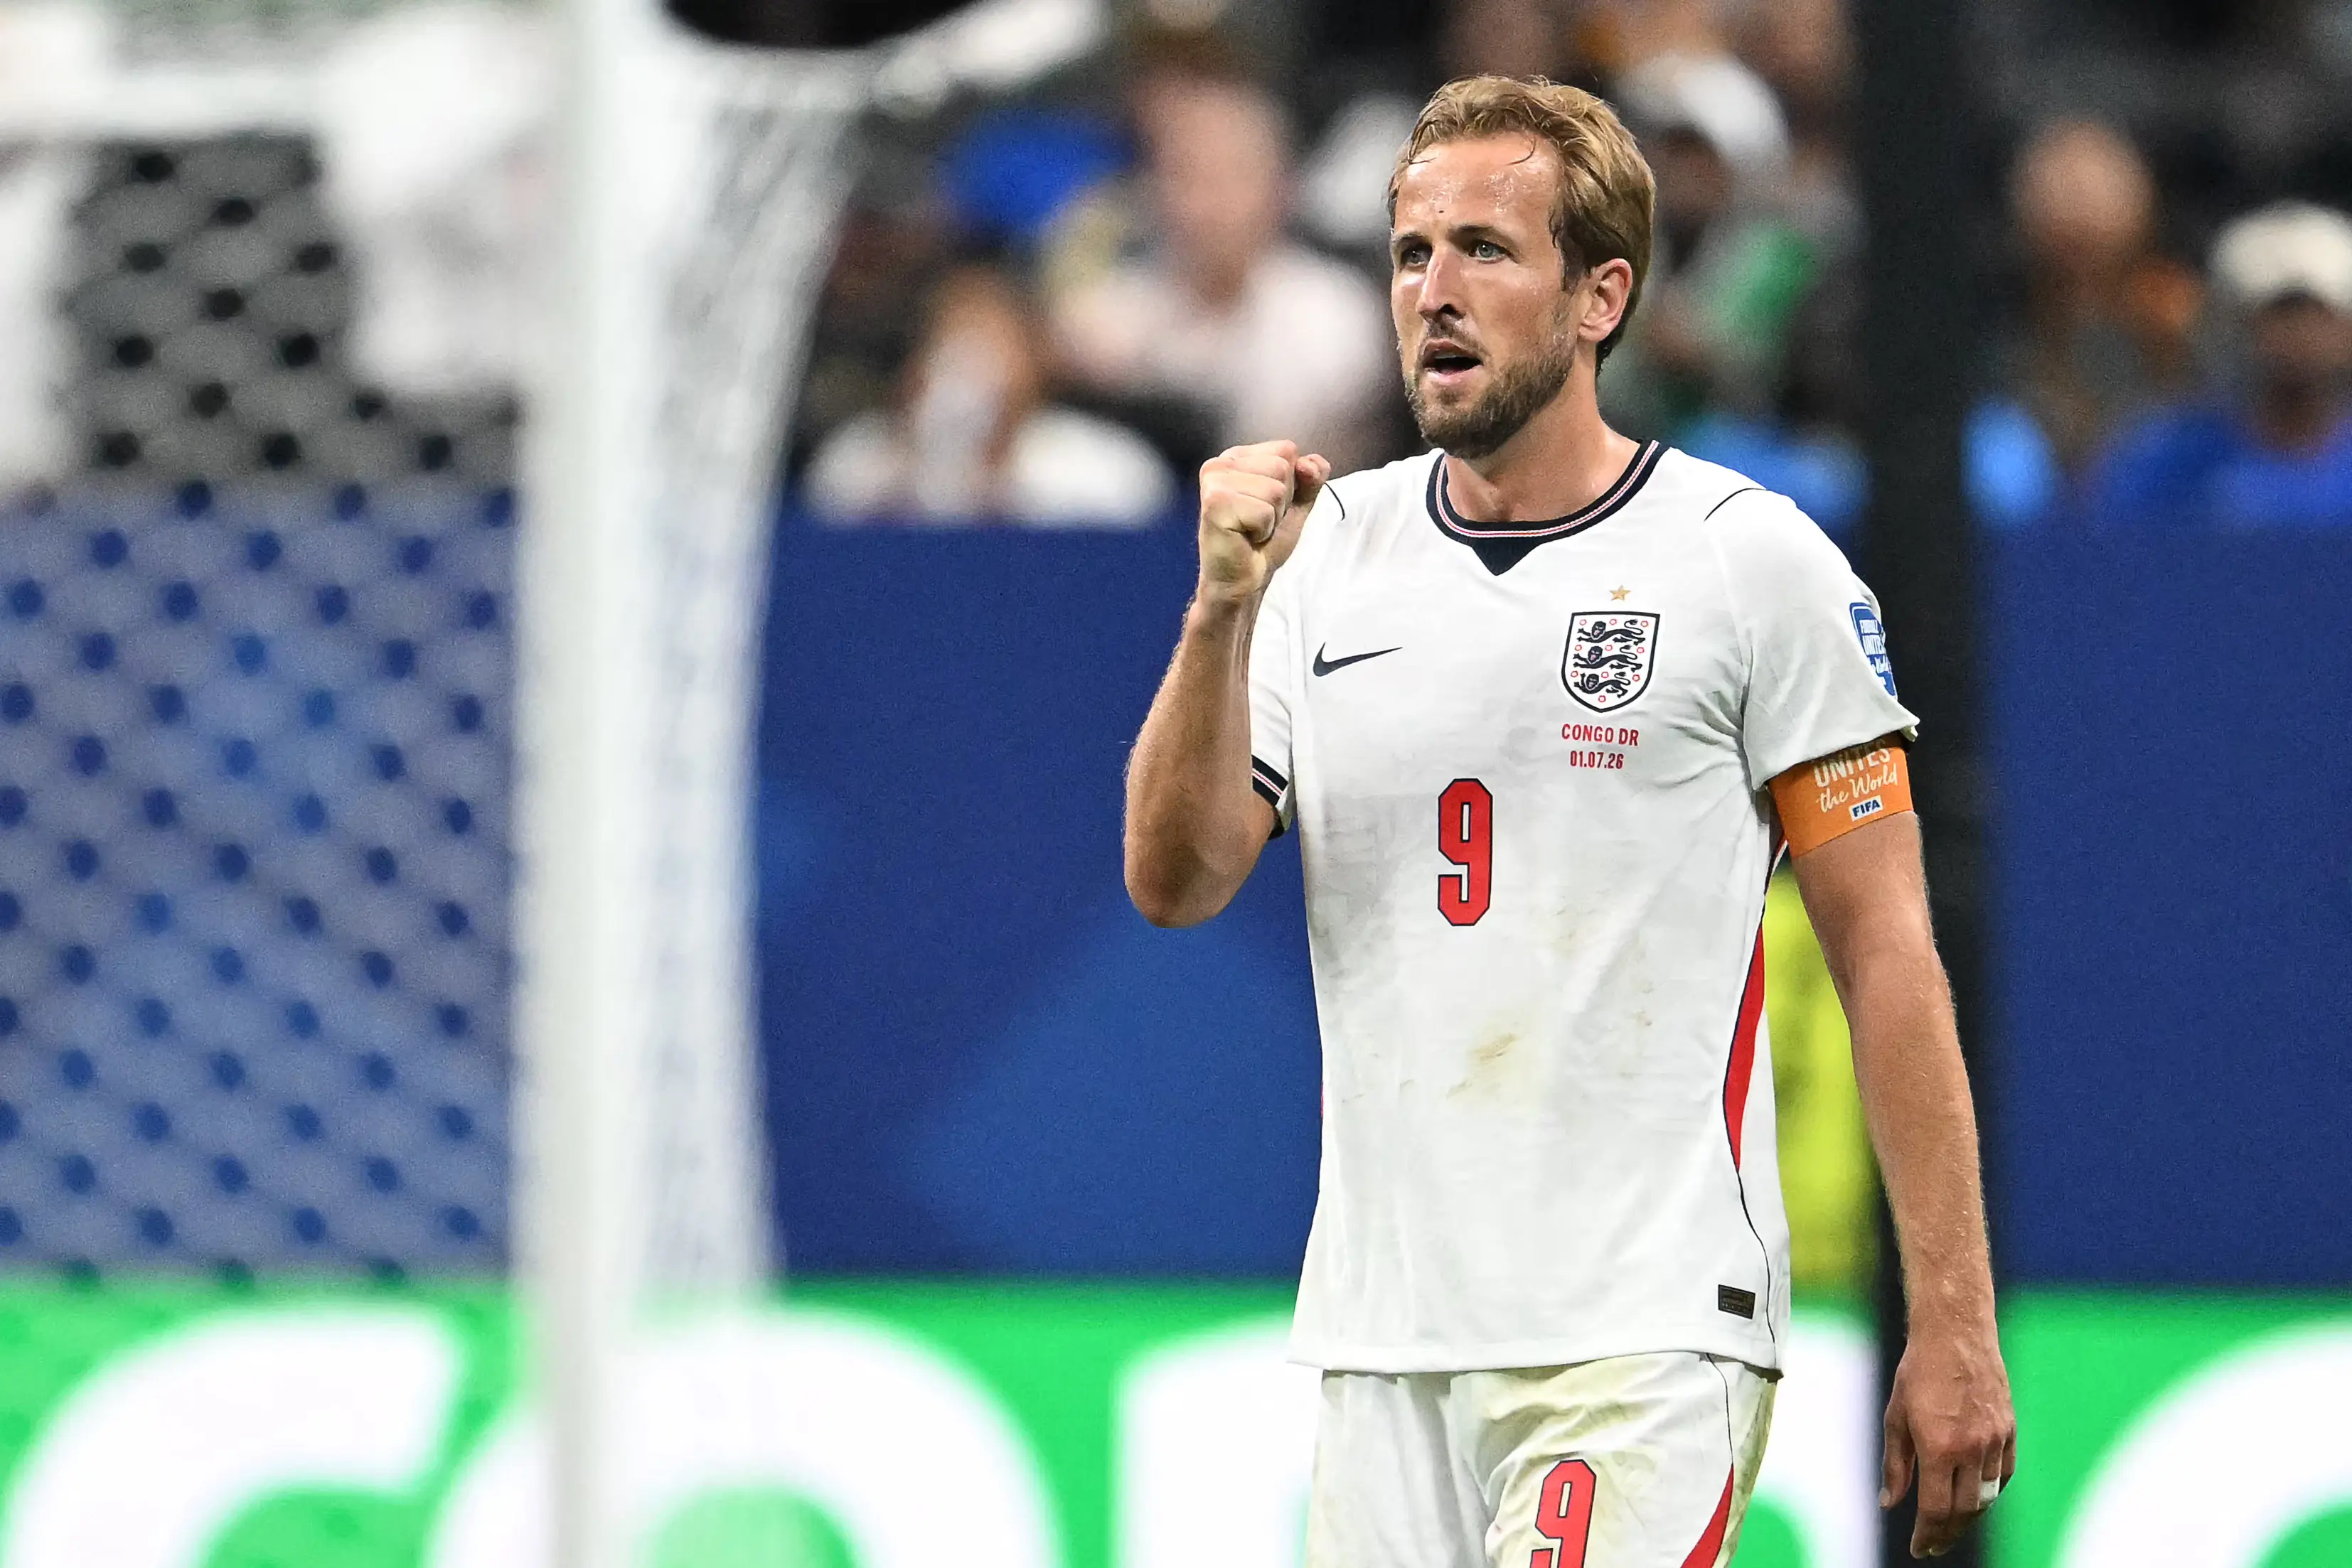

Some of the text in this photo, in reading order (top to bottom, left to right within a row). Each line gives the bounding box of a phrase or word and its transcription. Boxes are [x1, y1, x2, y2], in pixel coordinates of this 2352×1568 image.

[1561, 724, 1639, 746] CONGO DR
[1570, 750, 1624, 769] 01.07.26
[1816, 763, 1898, 813] the World
[1852, 800, 1880, 817] FIFA
[1438, 778, 1493, 926] 9
[1529, 1459, 1597, 1568] 9
